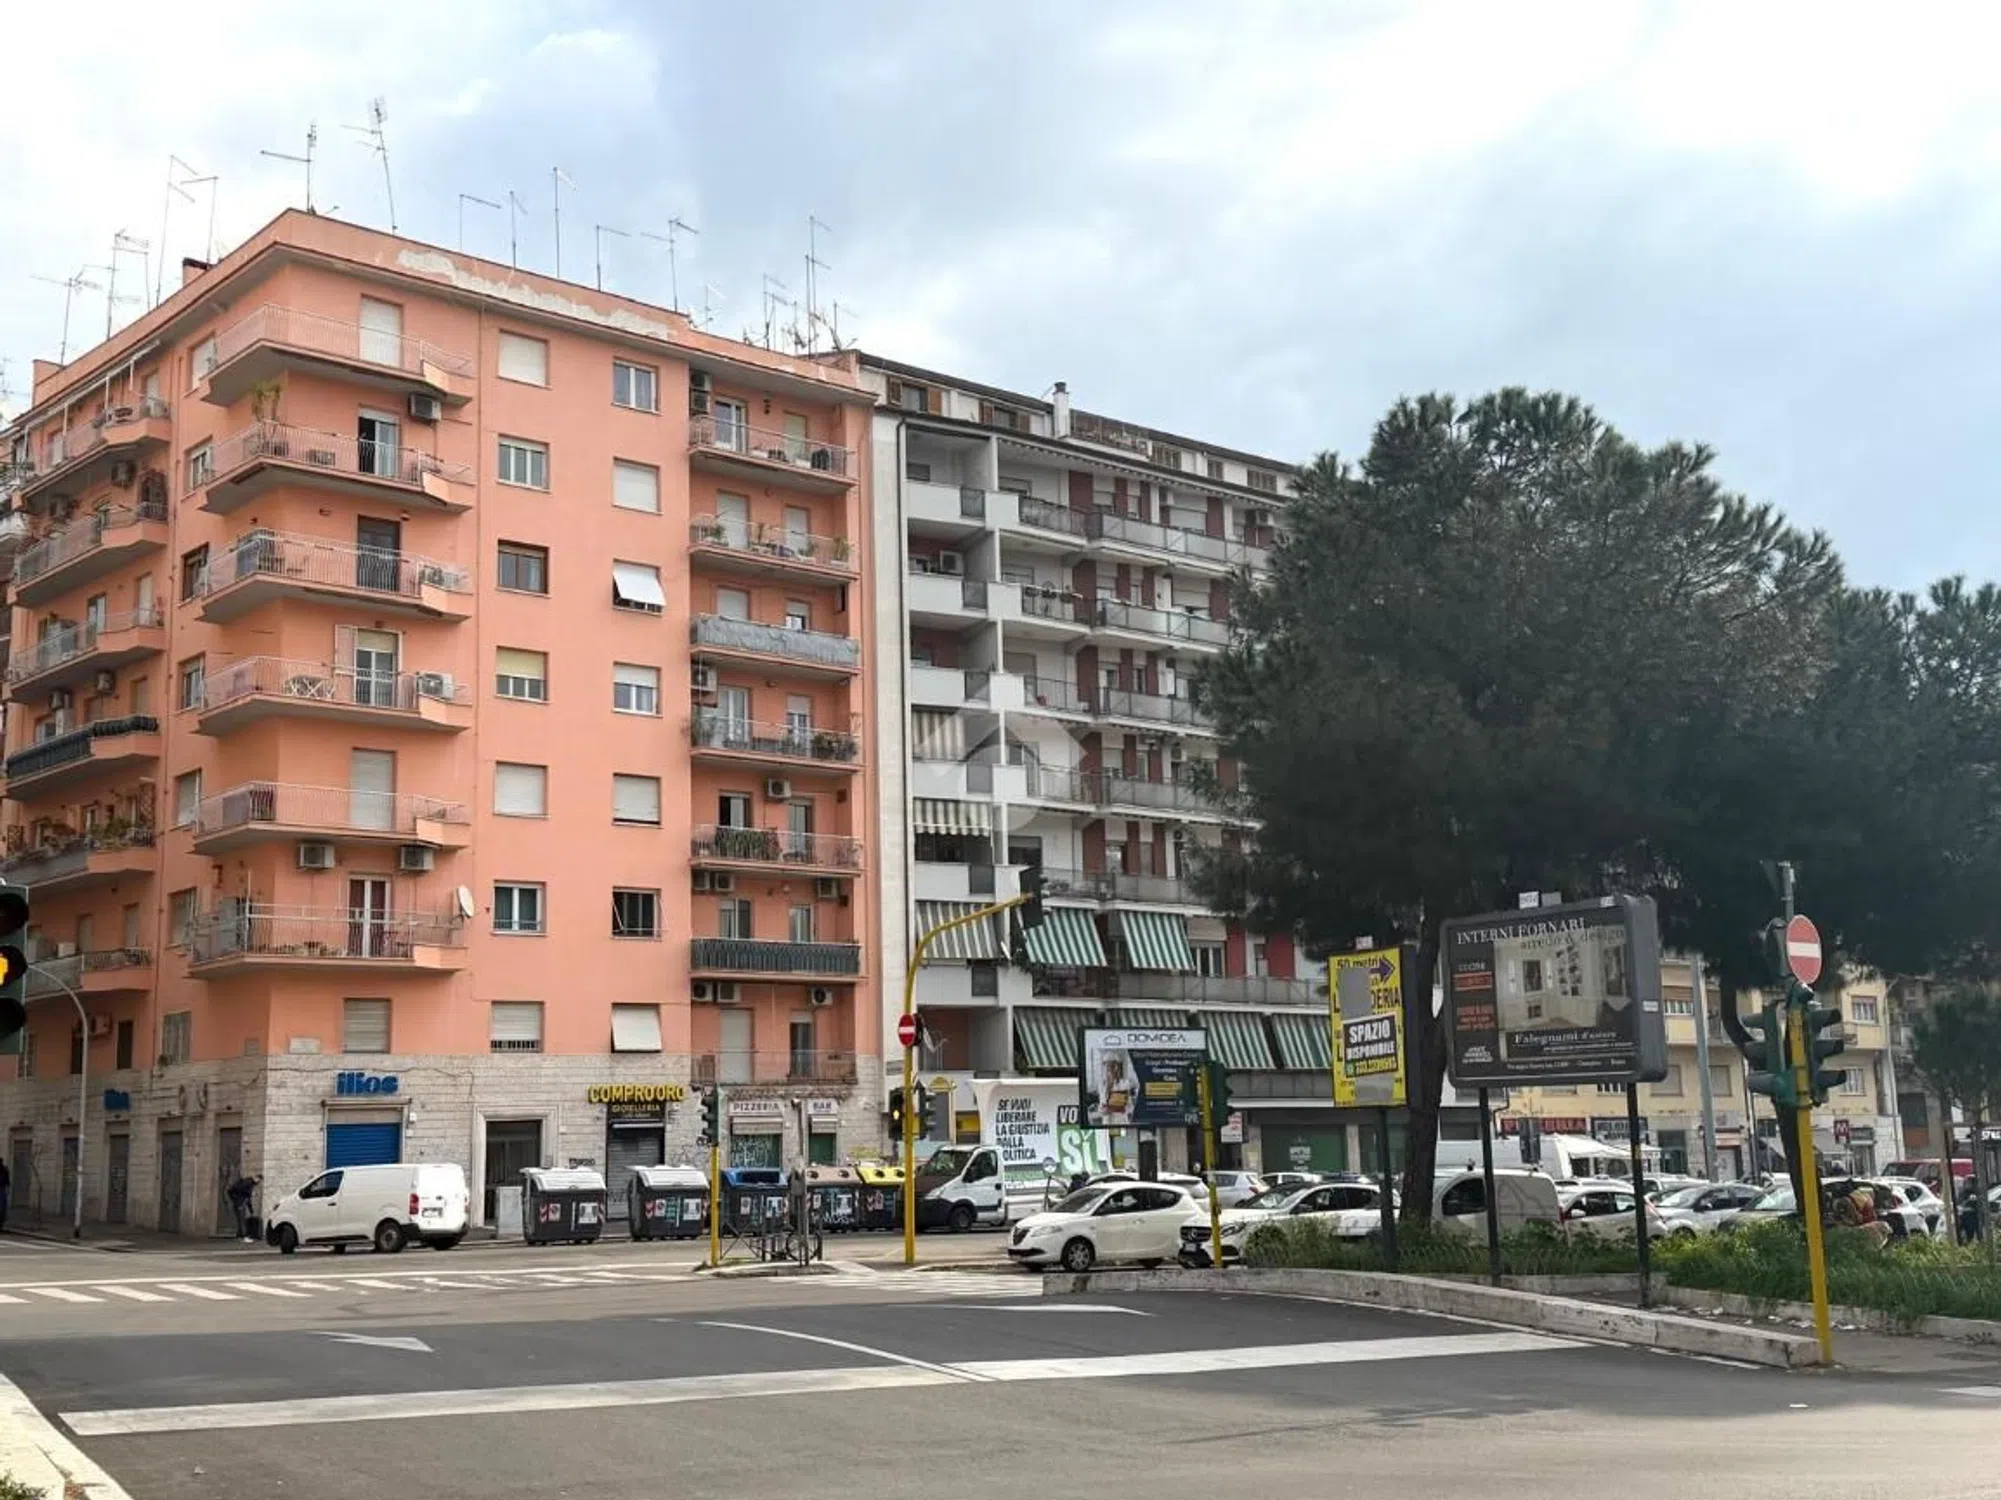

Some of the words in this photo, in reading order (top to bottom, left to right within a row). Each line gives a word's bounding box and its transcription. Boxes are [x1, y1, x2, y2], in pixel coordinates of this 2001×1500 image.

[1457, 926, 1513, 944] INTERNI
[1519, 917, 1586, 938] FORNARI
[1349, 1020, 1390, 1043] SPAZIO
[1346, 1040, 1395, 1060] DISPONIBILE
[733, 1101, 780, 1111] PIZZERIA
[813, 1101, 832, 1110] BAR
[997, 1098, 1009, 1111] SE
[995, 1111, 1037, 1123] LIBERARE
[995, 1123, 1007, 1136] LA
[1009, 1122, 1050, 1136] GIUSTIZIA
[1002, 1148, 1037, 1161] OLITICA
